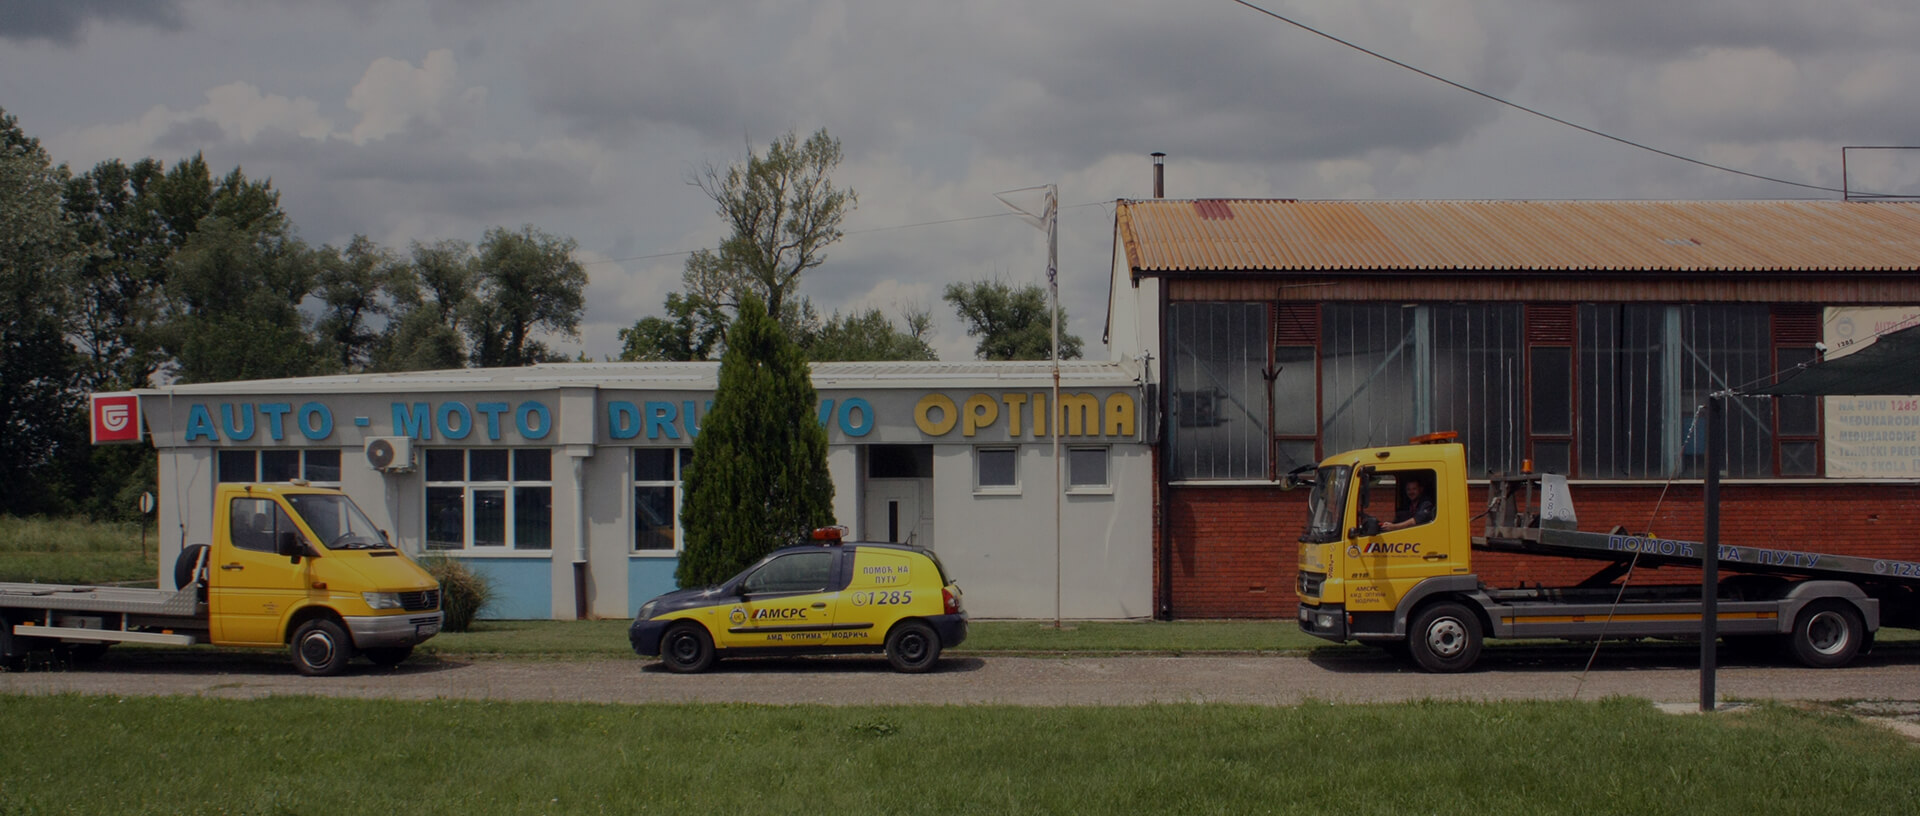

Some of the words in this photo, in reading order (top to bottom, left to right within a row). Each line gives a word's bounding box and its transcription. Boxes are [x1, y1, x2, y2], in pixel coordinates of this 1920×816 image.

[1837, 339, 1854, 348] 1285
[1858, 400, 1887, 411] PUTU
[1891, 400, 1918, 411] 1285
[185, 402, 333, 441] AUTO
[392, 401, 552, 440] MOTO
[914, 393, 1135, 436] OPTIMA
[1547, 484, 1555, 520] 1285
[1609, 536, 1693, 556] ПОМОЋ
[1759, 549, 1820, 567] ПУТУ
[898, 566, 909, 574] НА
[875, 576, 897, 584] ПУТУ
[868, 591, 912, 605] 1285
[831, 631, 868, 639] МОДРИЧА
